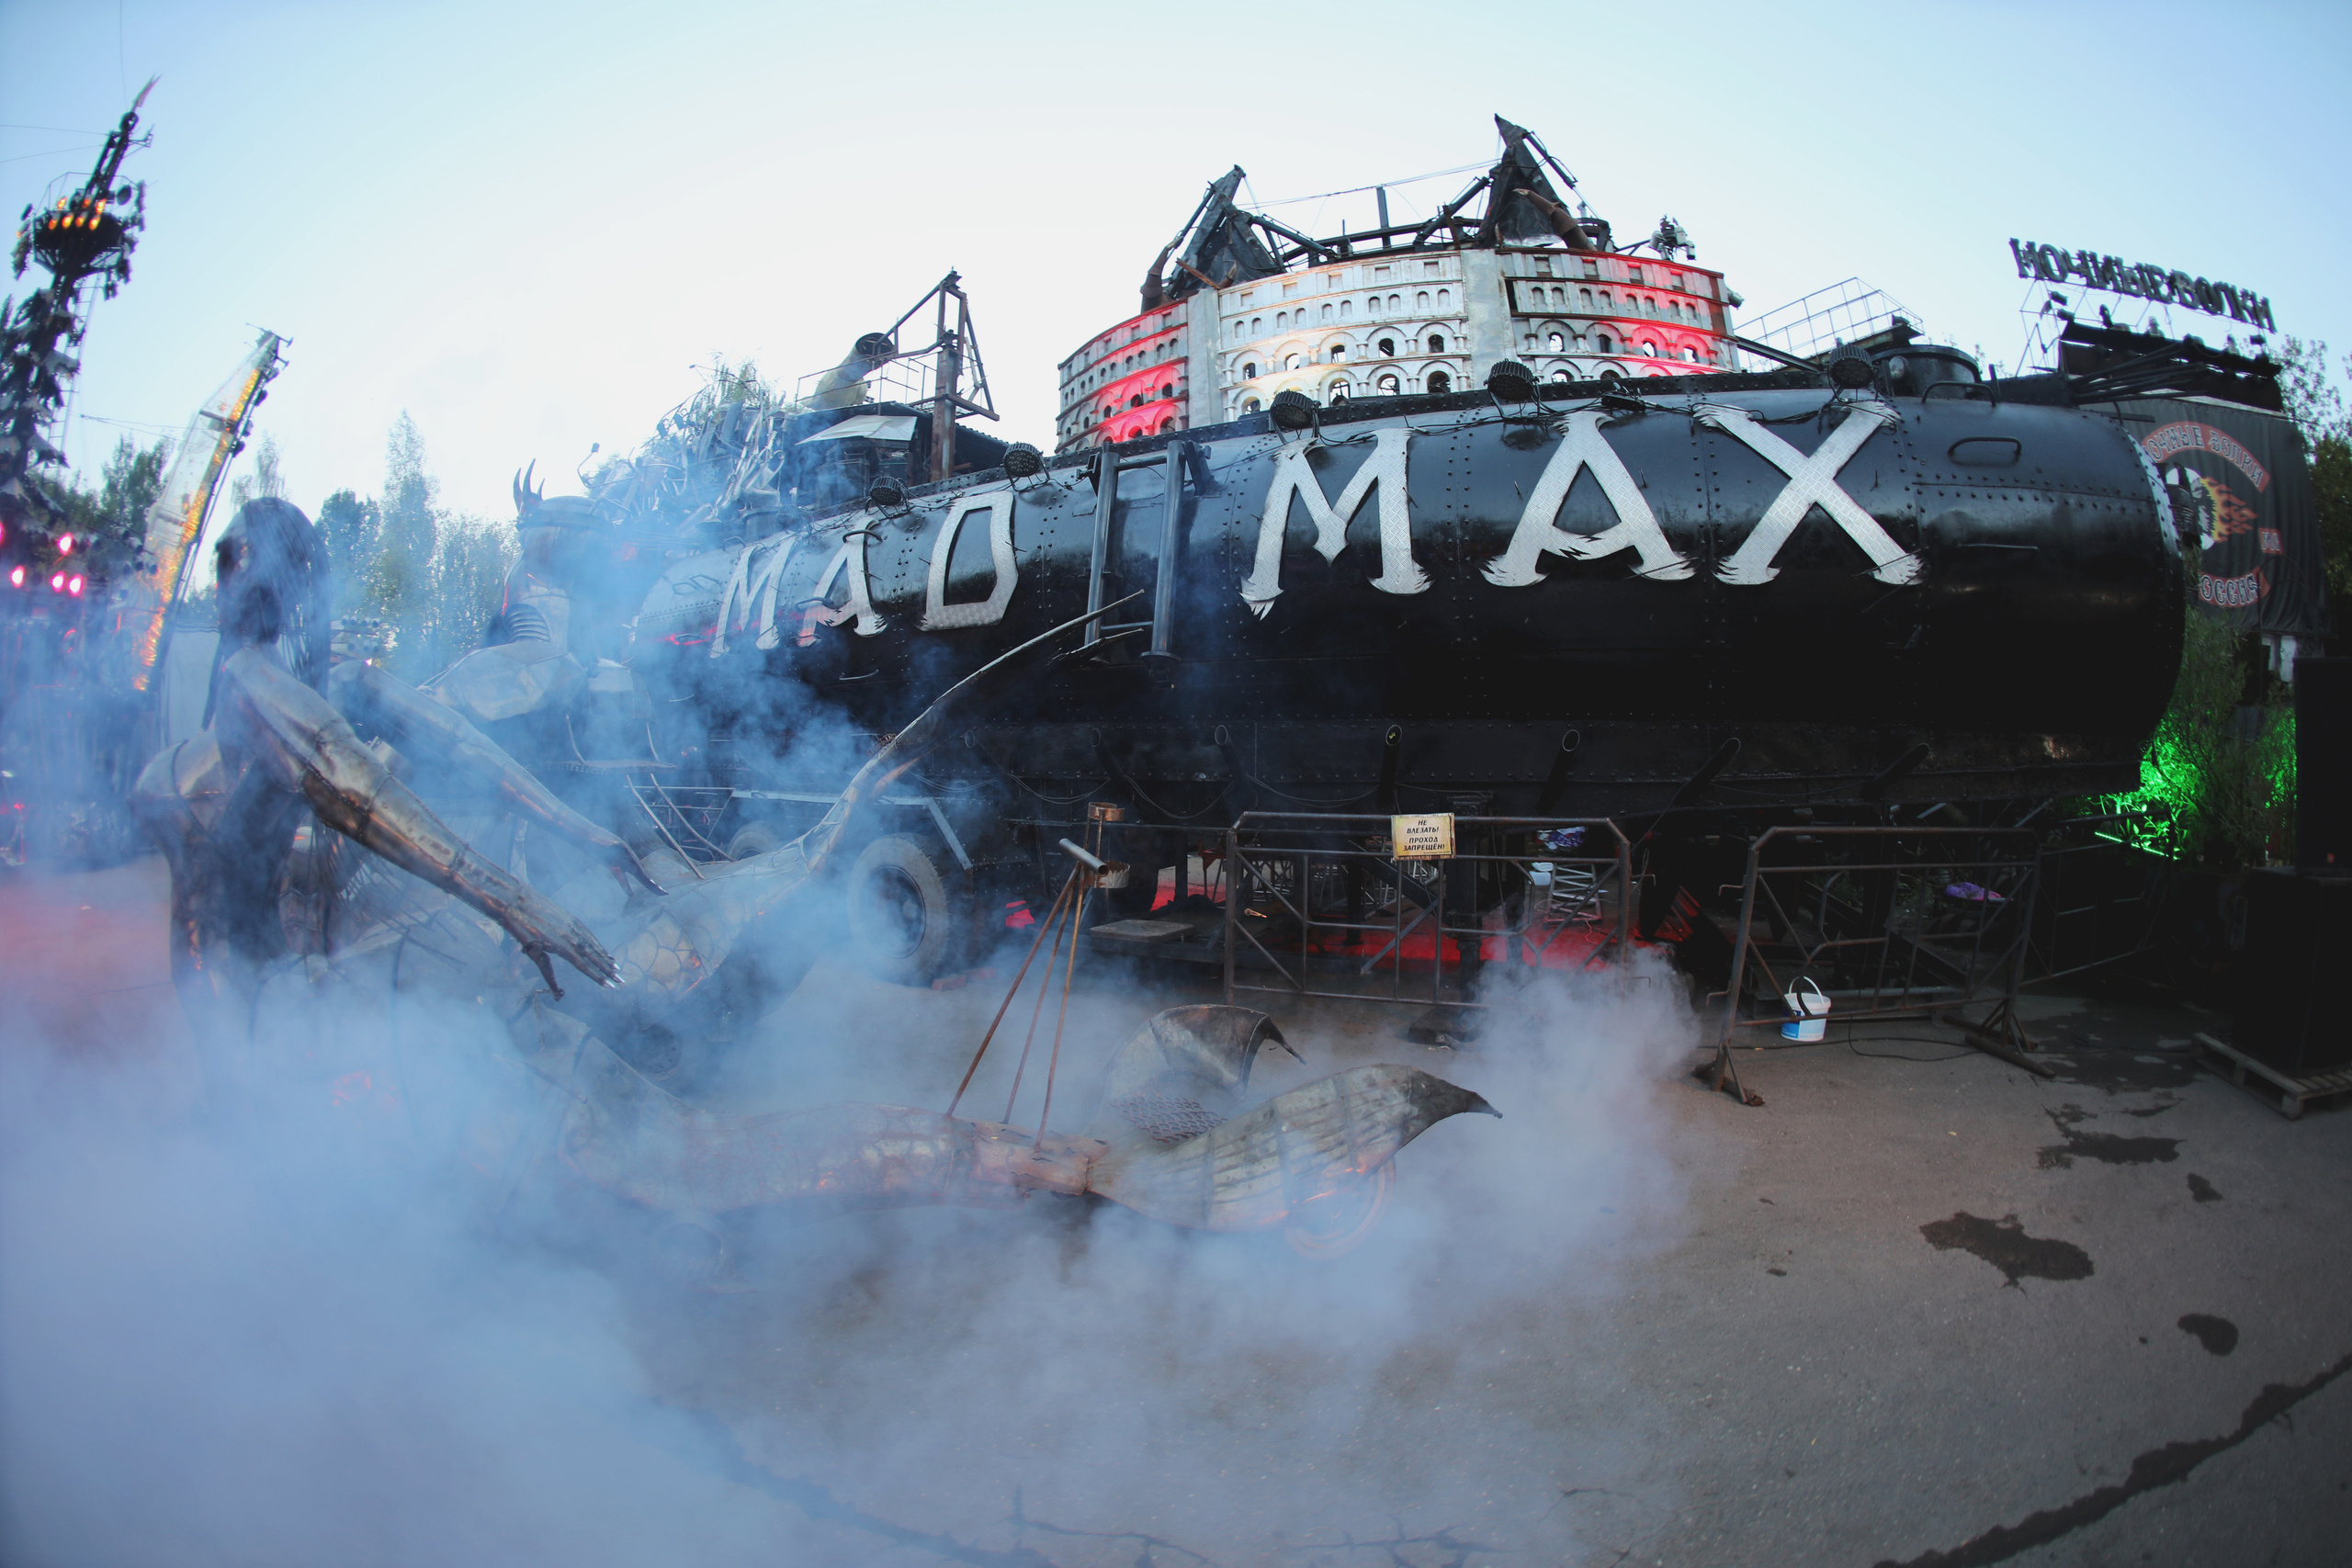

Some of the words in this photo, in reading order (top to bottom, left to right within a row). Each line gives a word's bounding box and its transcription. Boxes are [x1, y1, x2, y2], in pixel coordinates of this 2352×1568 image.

[2169, 268, 2278, 334] ВОЛКИ
[2142, 424, 2205, 462] ОЧНЫЕ
[2208, 430, 2264, 488] ВОЛКИ
[709, 491, 1019, 659] MAD
[1239, 400, 1926, 621] MAX
[2199, 572, 2259, 606] ОССИЯ
